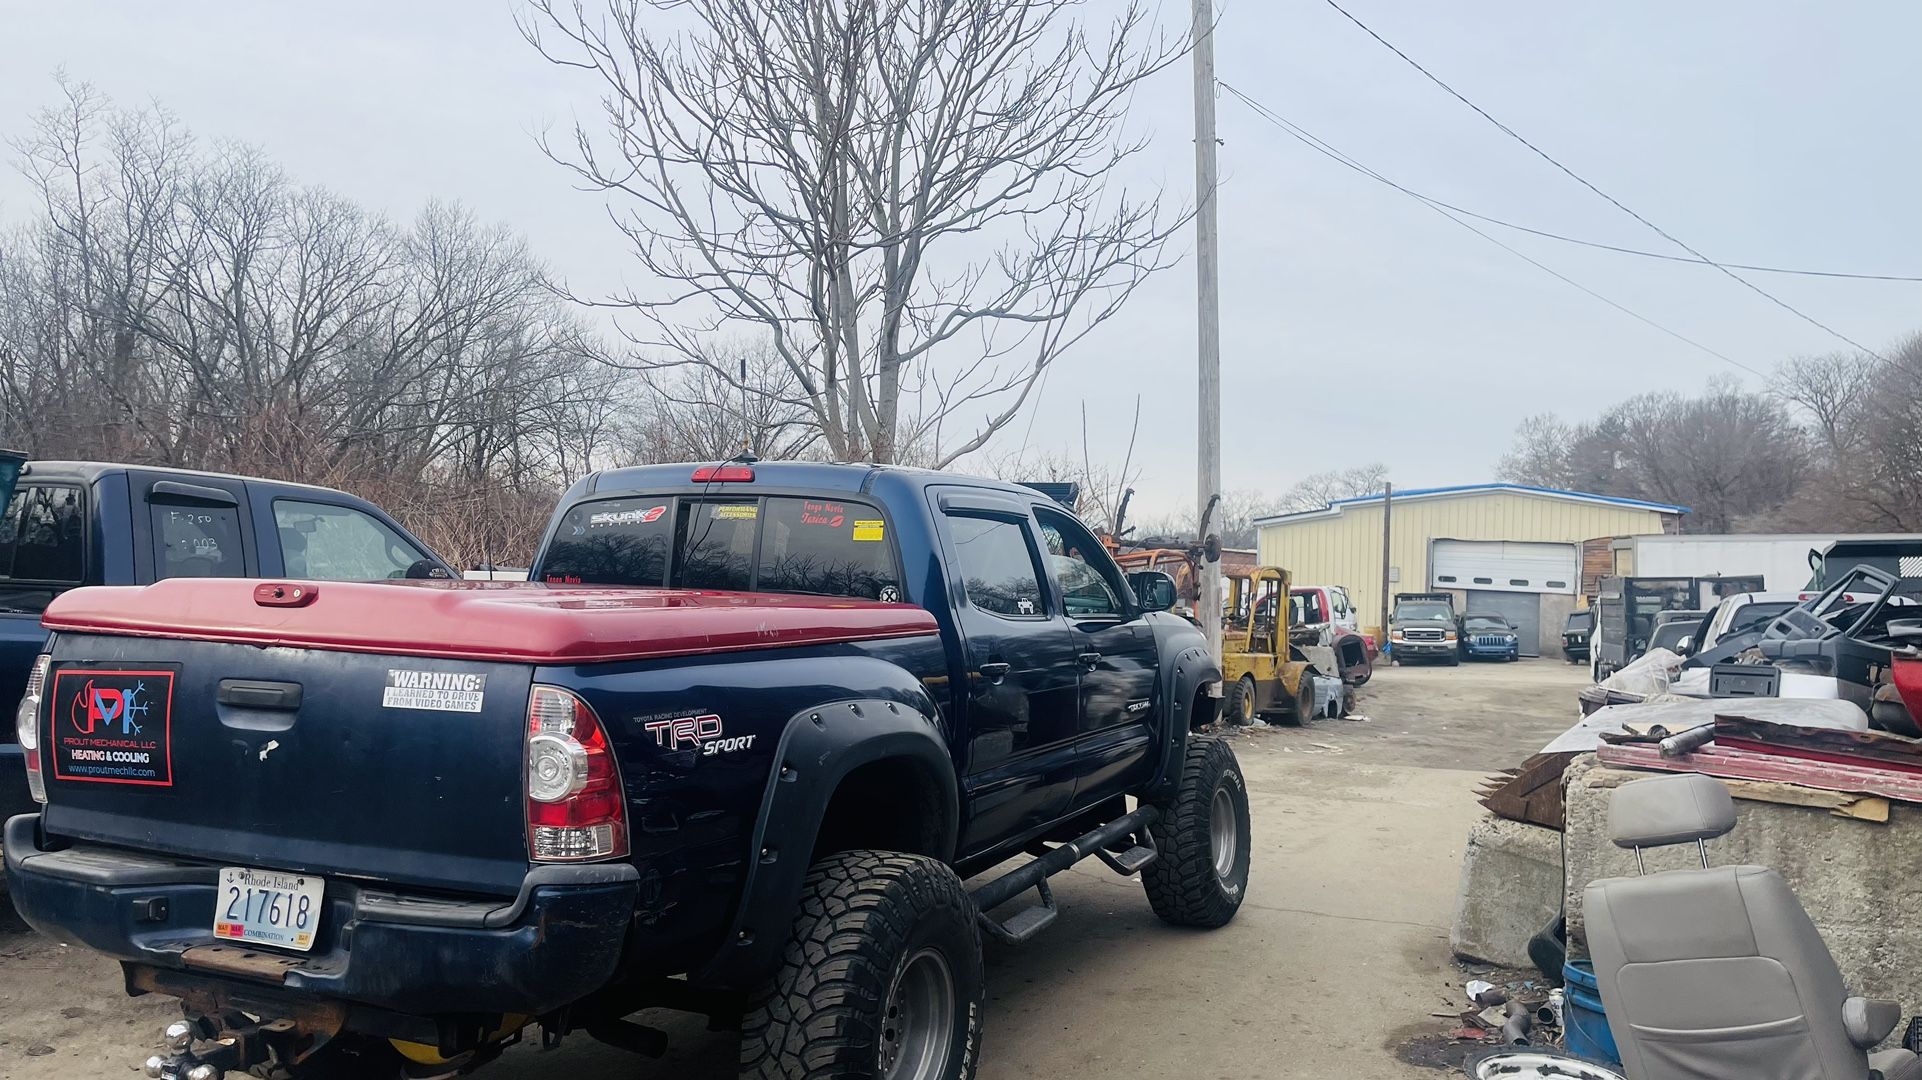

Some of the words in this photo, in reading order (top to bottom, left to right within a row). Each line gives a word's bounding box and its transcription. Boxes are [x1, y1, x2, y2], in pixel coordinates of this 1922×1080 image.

[394, 671, 481, 691] WARNING:
[392, 688, 434, 699] LEARNED
[437, 690, 449, 700] TO
[451, 691, 480, 702] DRIVE
[387, 697, 412, 707] FROM
[415, 698, 442, 709] VIDEO
[633, 715, 654, 723] TOYOTA
[654, 711, 673, 721] RACING
[674, 708, 708, 718] DEVELOPMENT
[645, 714, 722, 750] TRD
[63, 737, 89, 746] PROUT
[90, 738, 139, 748] MECHANICAL
[141, 740, 156, 749] LLC
[702, 734, 757, 756] SPORT
[71, 749, 105, 761] HEATING
[105, 750, 112, 762] &
[112, 751, 150, 764] COOLING
[68, 764, 156, 777] www.proutmechllc.com
[244, 872, 271, 888] Rhode
[273, 876, 300, 891] Island
[226, 886, 310, 930] 217618
[243, 929, 285, 942] COMBINATION
